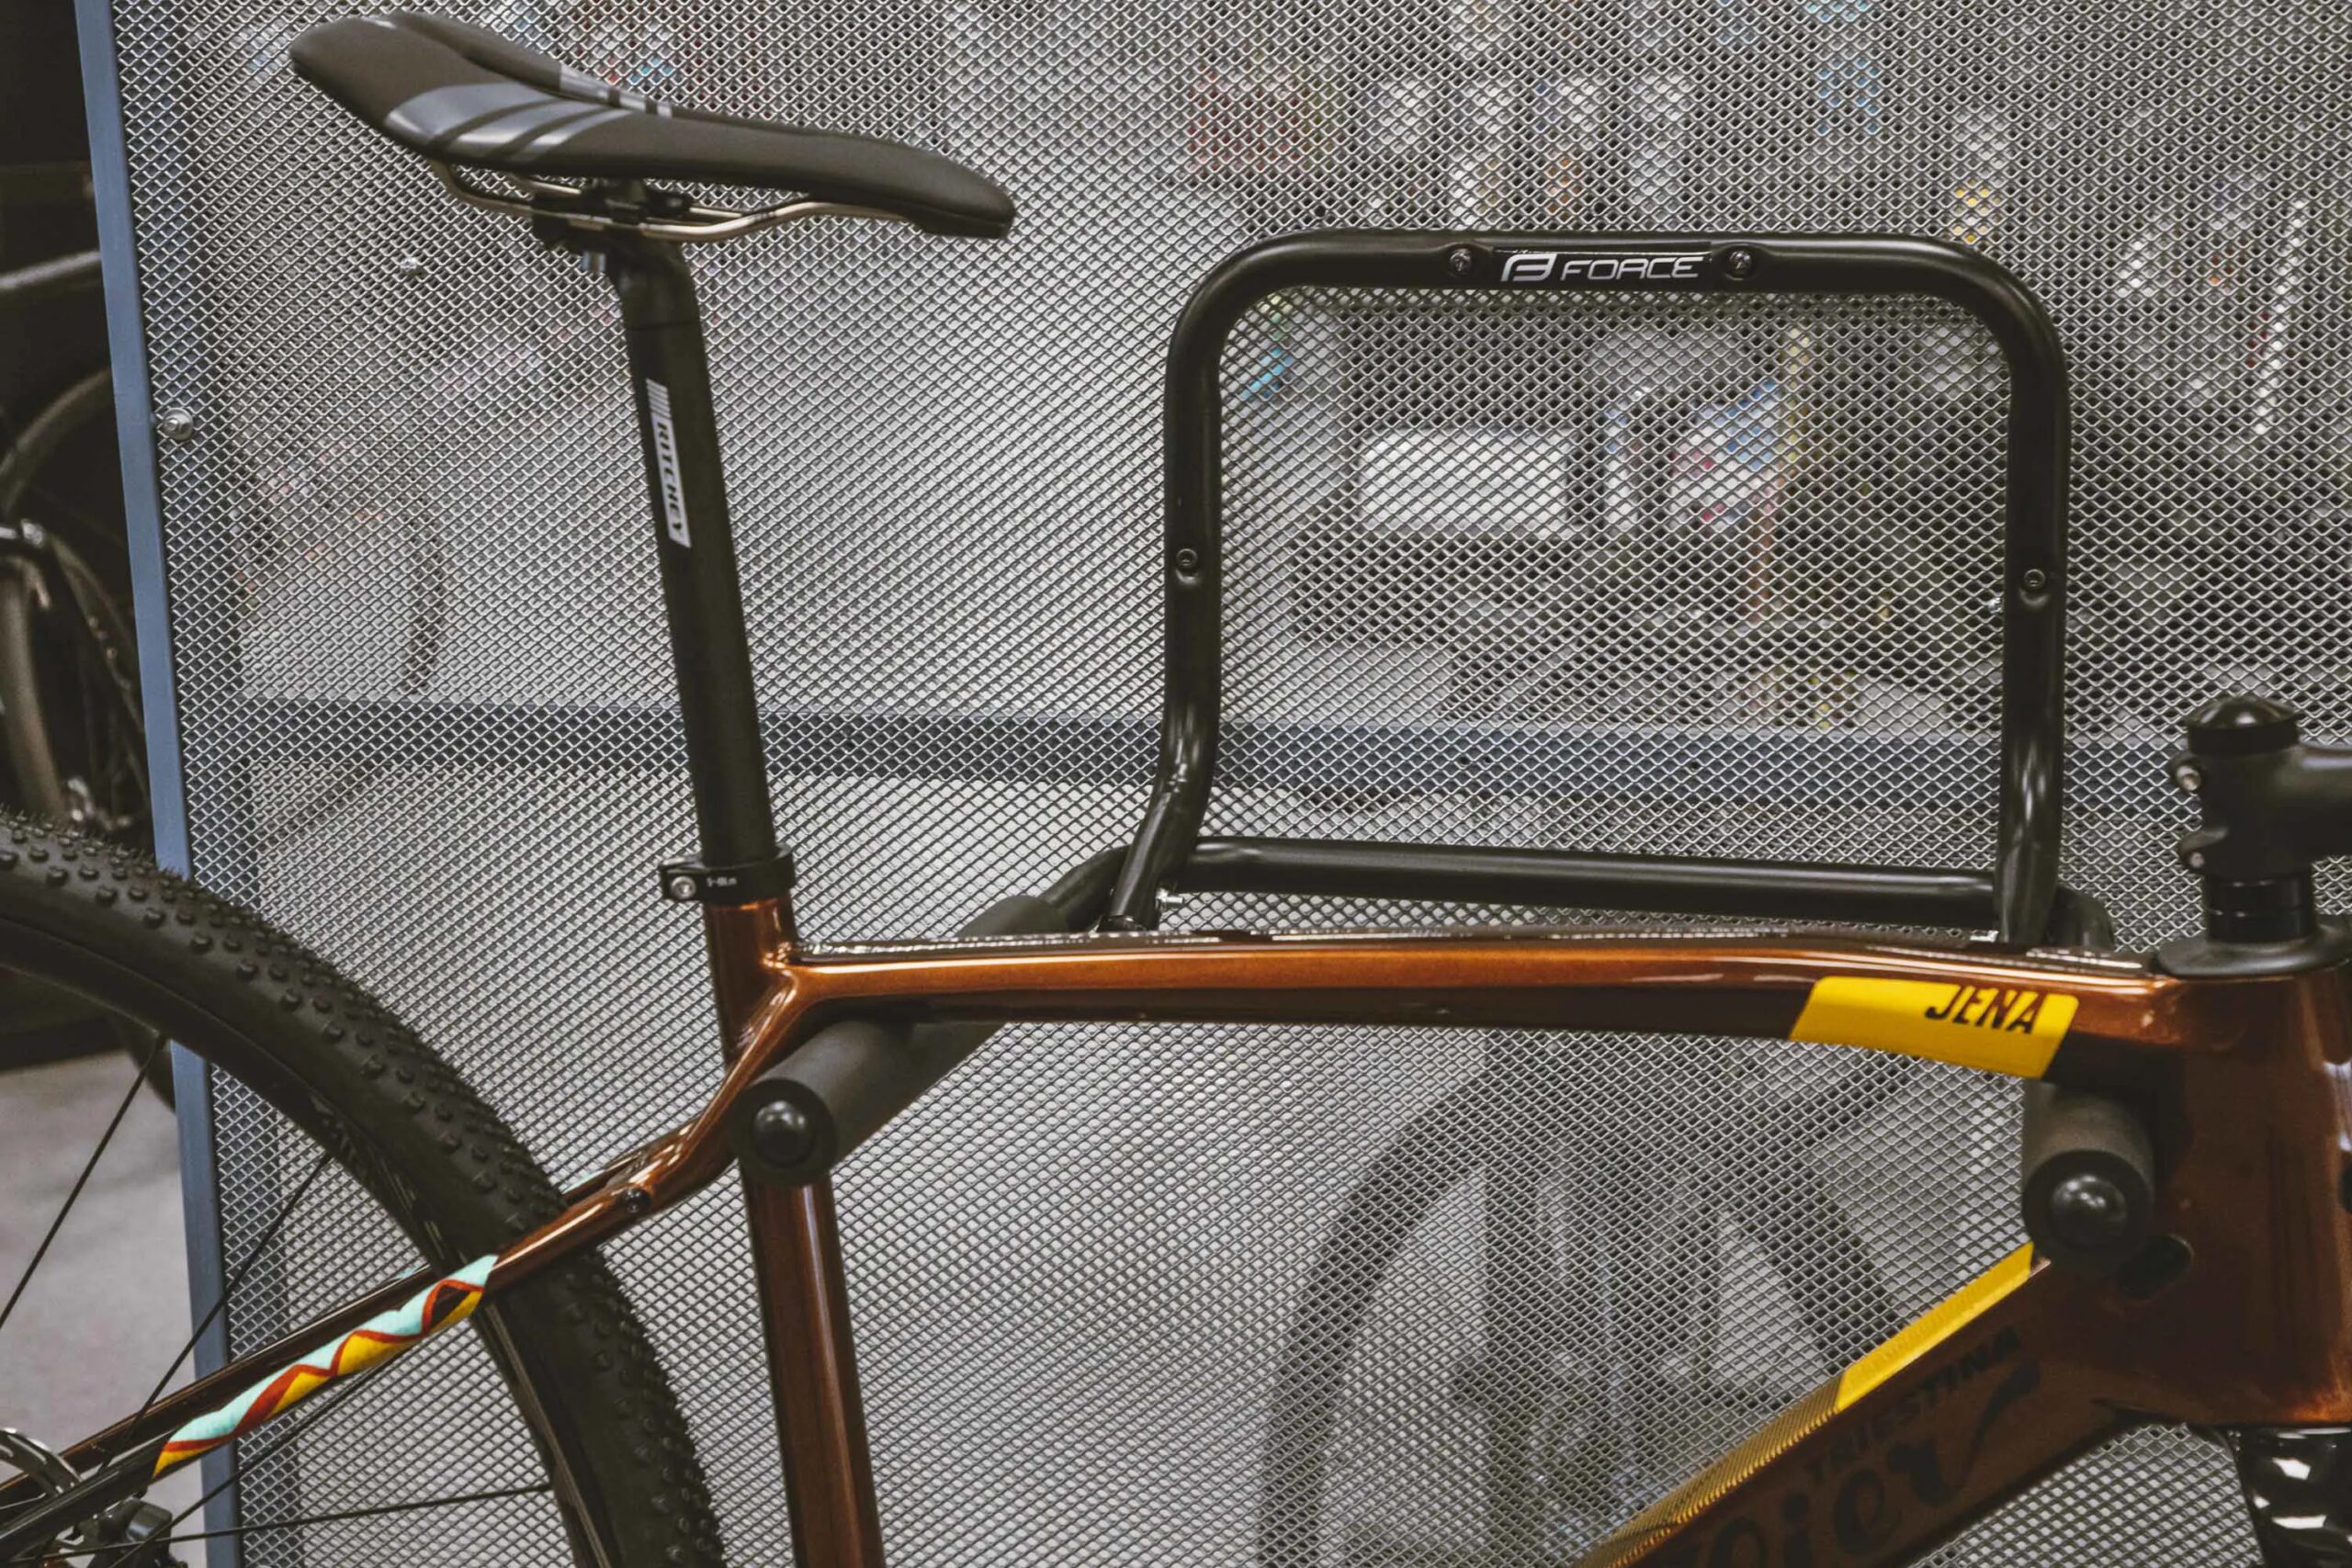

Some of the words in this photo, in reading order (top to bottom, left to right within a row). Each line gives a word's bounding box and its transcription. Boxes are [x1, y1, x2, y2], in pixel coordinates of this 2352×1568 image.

[1560, 255, 1703, 281] FORCE
[656, 421, 683, 533] RITCHEY
[1924, 982, 2047, 1034] JENA
